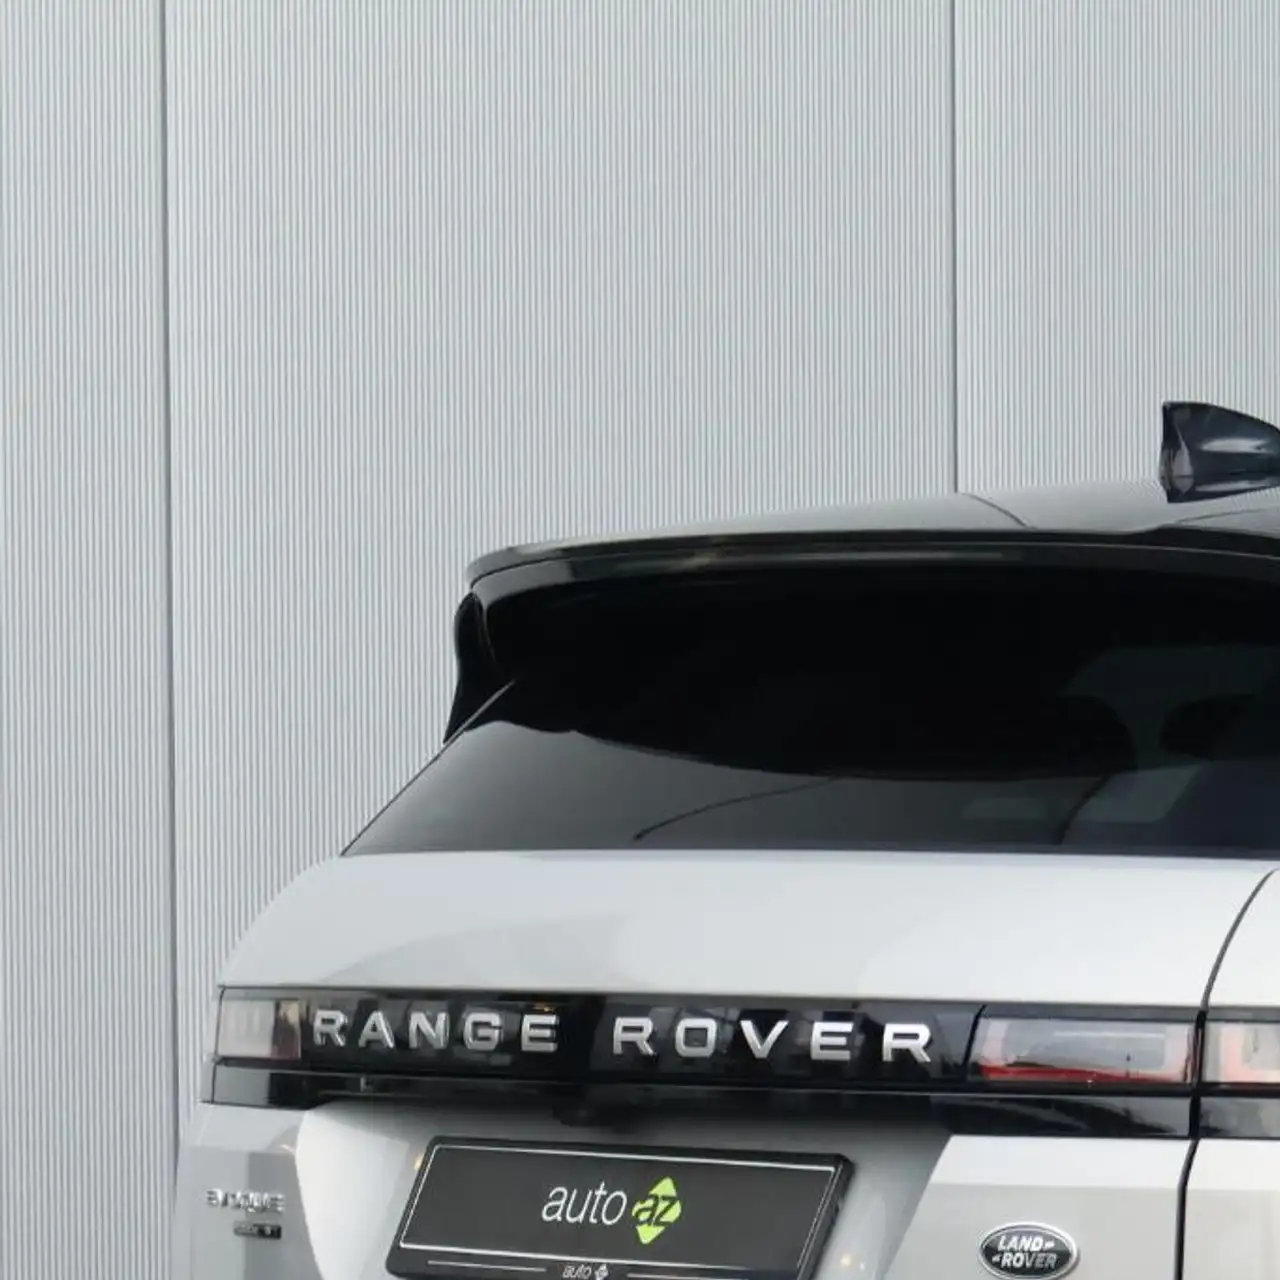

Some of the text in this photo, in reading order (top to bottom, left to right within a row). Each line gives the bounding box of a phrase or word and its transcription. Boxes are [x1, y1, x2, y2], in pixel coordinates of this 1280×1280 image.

[312, 1009, 932, 1063] RANGE ROVER
[541, 1181, 628, 1226] auto
[997, 1235, 1044, 1252] LAND
[1001, 1251, 1058, 1269] ROVER
